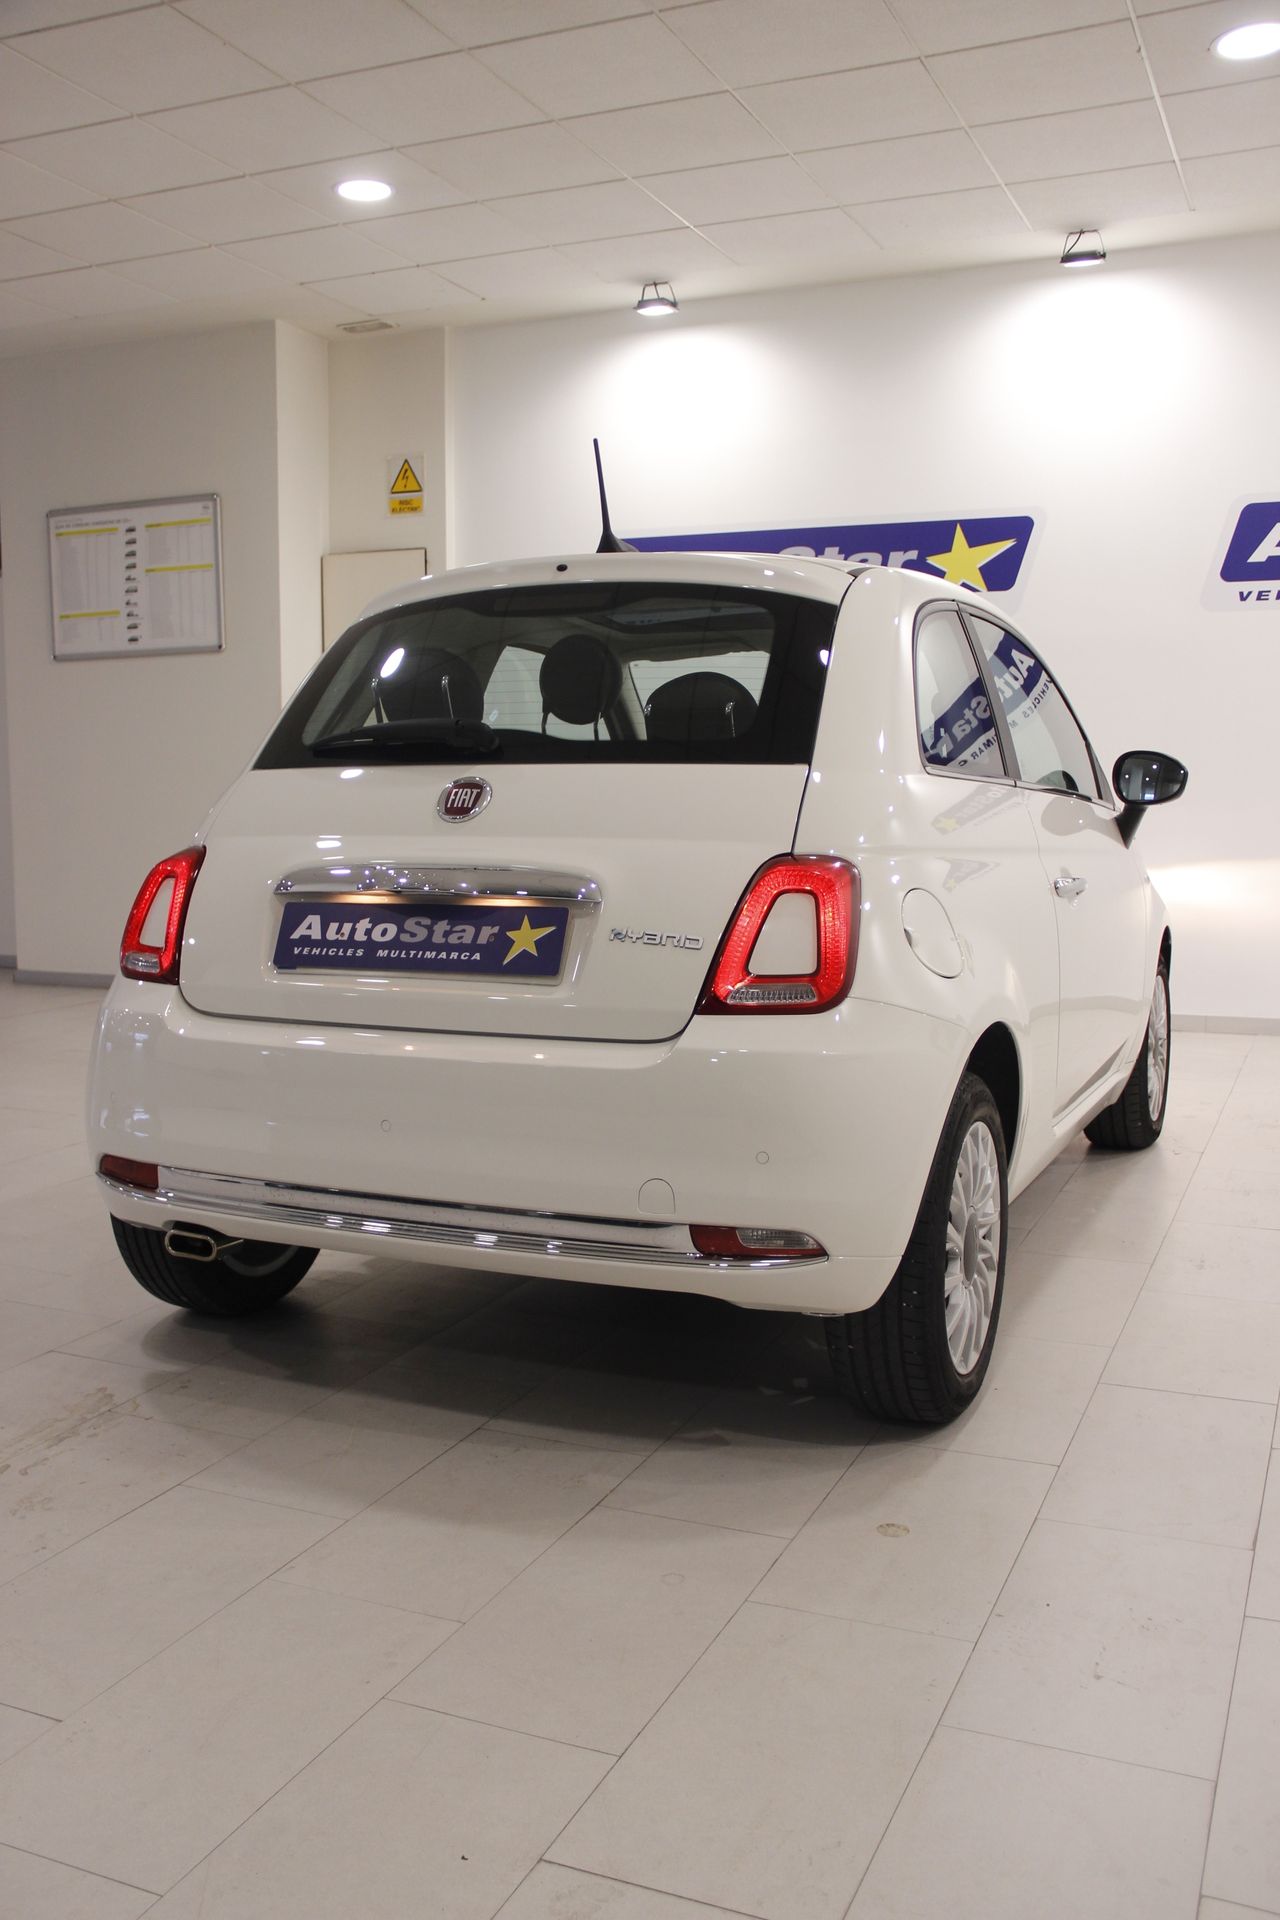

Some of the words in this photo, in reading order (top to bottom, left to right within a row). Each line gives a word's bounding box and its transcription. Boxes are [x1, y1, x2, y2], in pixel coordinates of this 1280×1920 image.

[447, 789, 480, 808] FIAT
[290, 914, 499, 945] AutoStar
[609, 928, 704, 951] HYBRID
[293, 947, 365, 957] VEHICLES
[376, 949, 481, 961] MULTIMARCA
